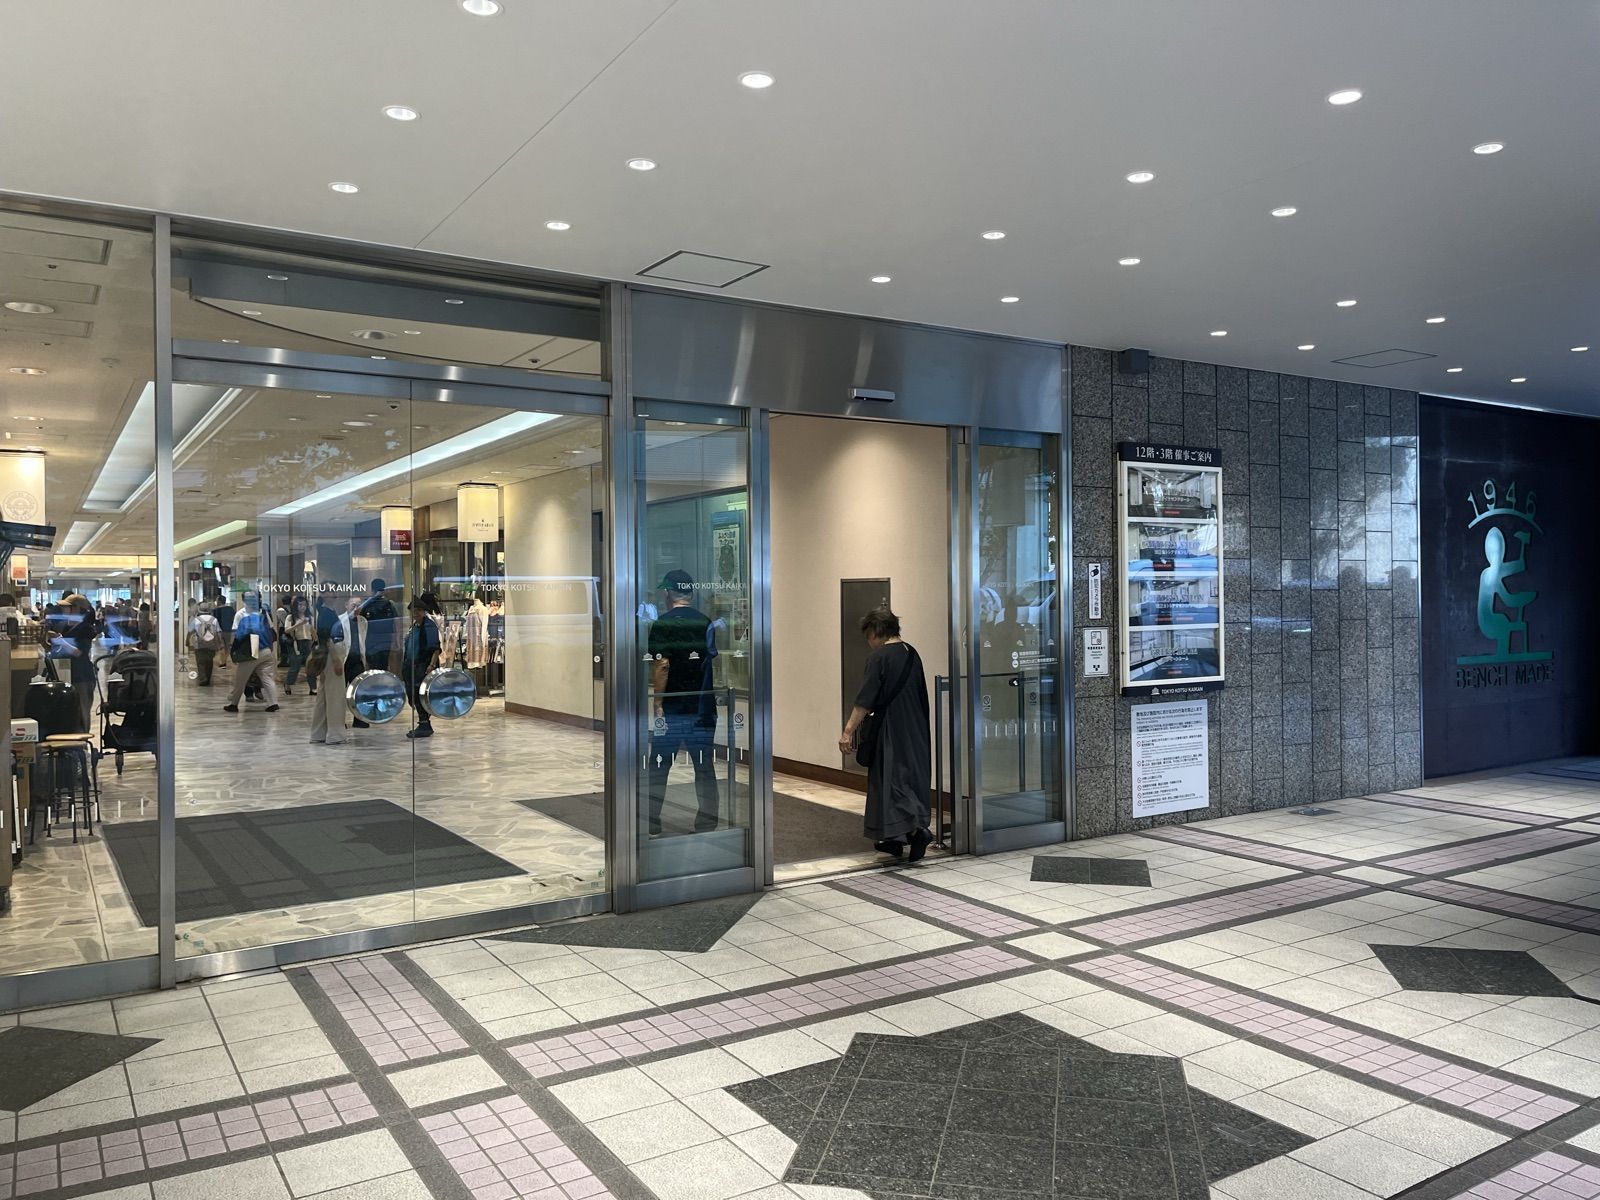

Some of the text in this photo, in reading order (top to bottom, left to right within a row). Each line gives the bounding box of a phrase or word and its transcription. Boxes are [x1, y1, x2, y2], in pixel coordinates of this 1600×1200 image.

[1175, 448, 1212, 462] 催事ご案内
[1467, 479, 1537, 521] 1946
[257, 583, 367, 593] TOKYO KOTSU KAIKAN
[481, 583, 508, 592] TOKYO
[677, 582, 700, 590] TOKYO
[701, 582, 724, 590] KOTSU
[1456, 662, 1554, 689] BENCH MADE
